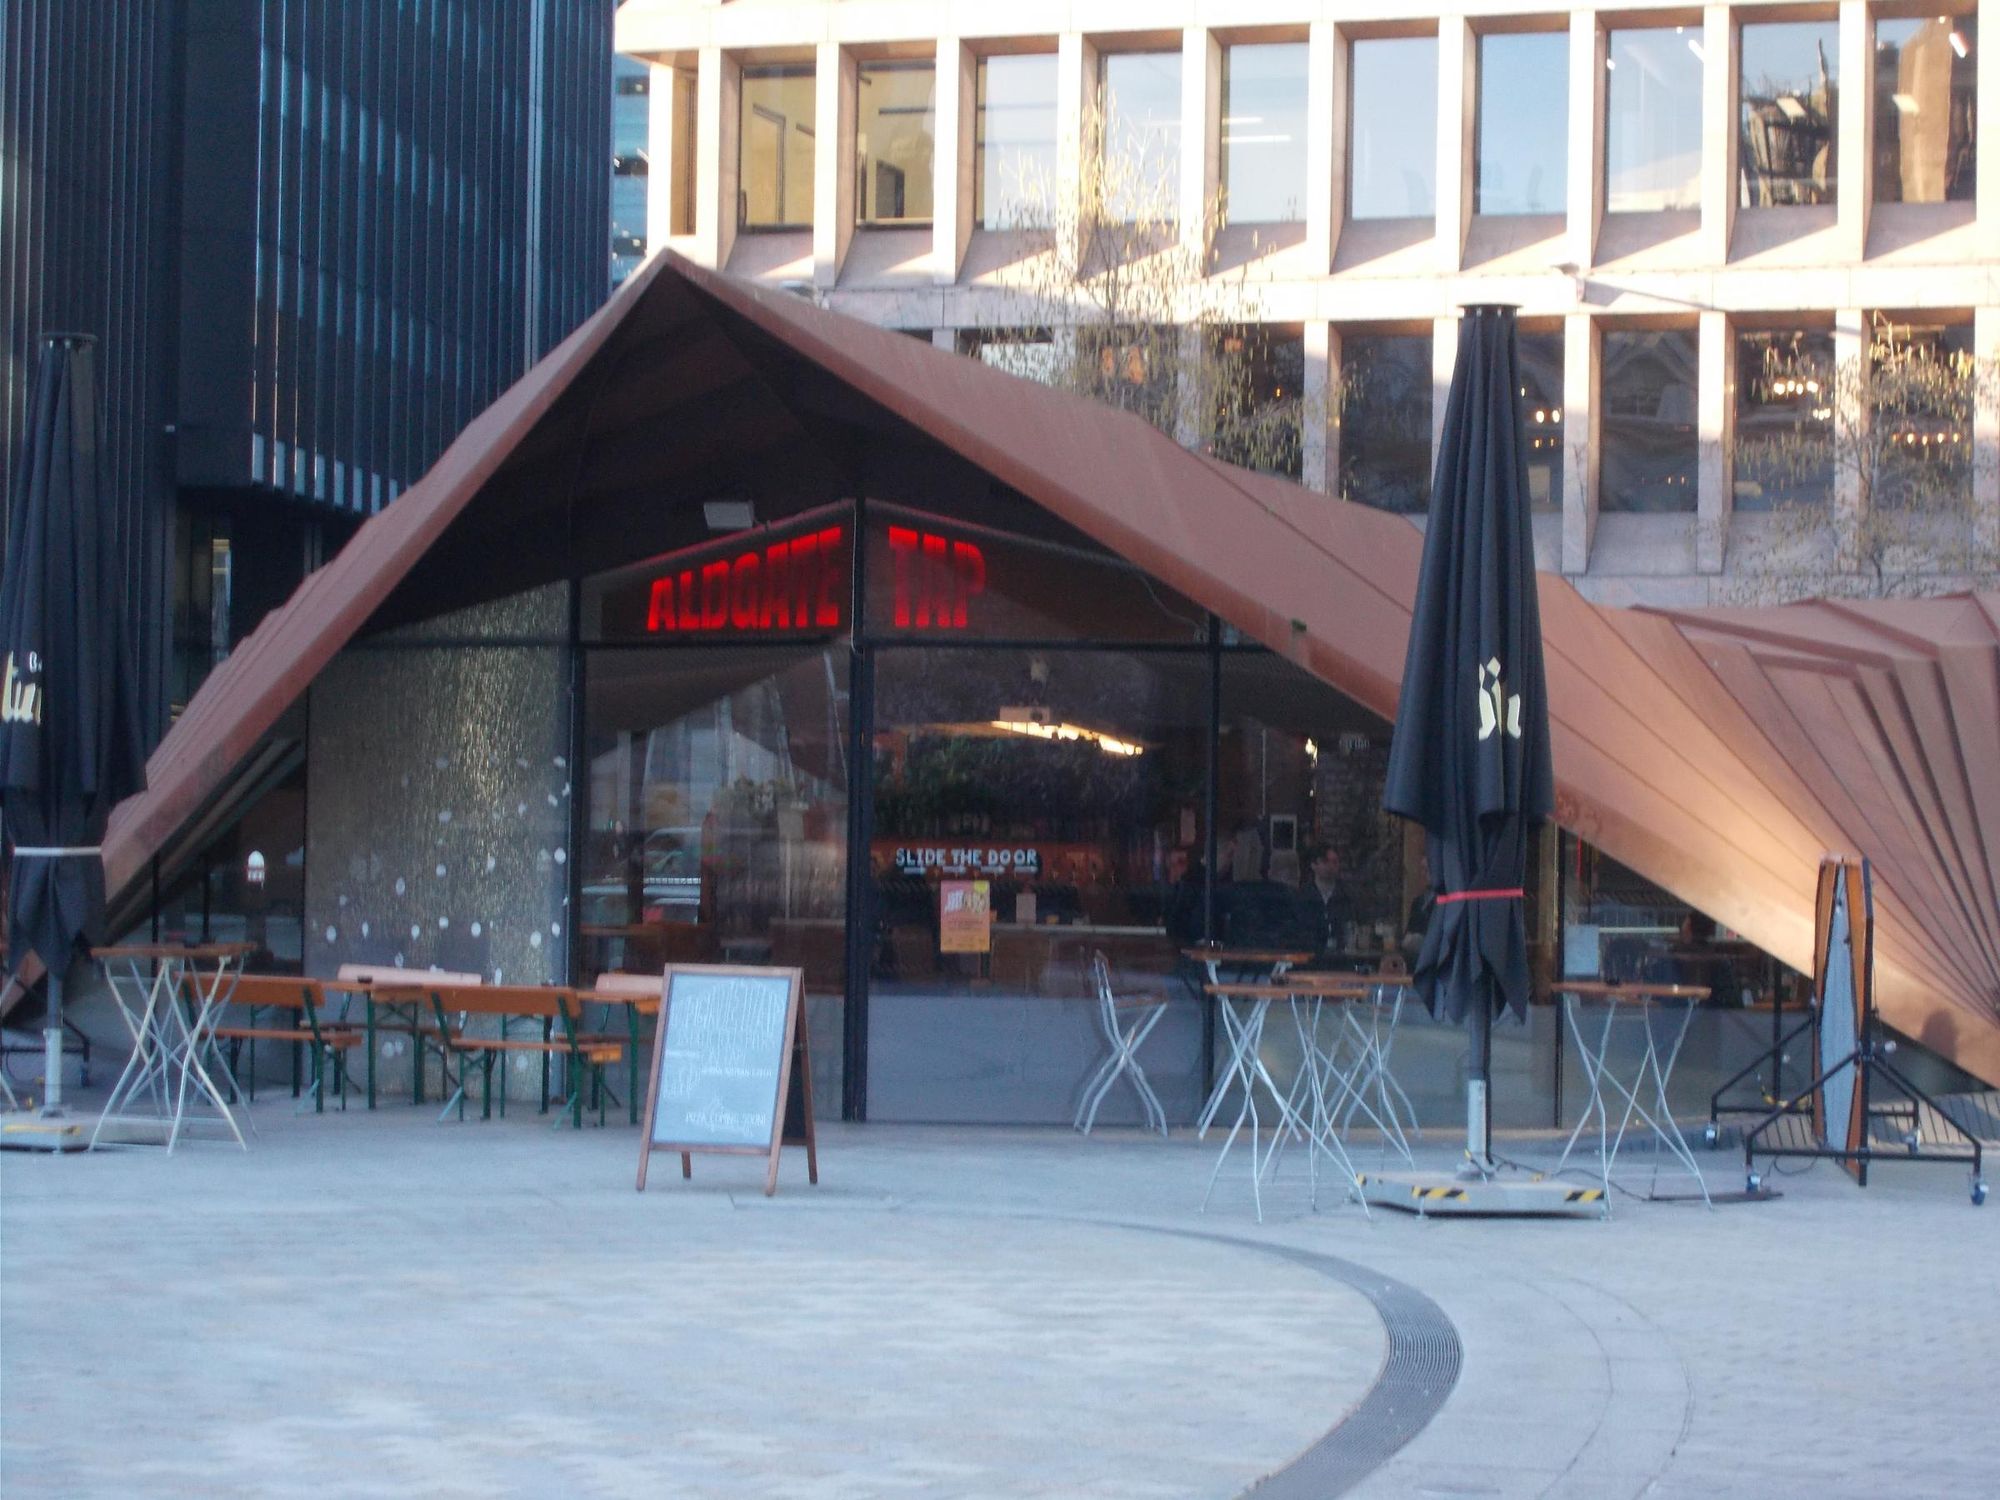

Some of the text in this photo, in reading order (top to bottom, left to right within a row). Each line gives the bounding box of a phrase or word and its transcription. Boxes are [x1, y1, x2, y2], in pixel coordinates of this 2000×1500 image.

[646, 525, 987, 631] ALDGATE TAP
[895, 847, 1038, 867] SLIDE THE DOOR
